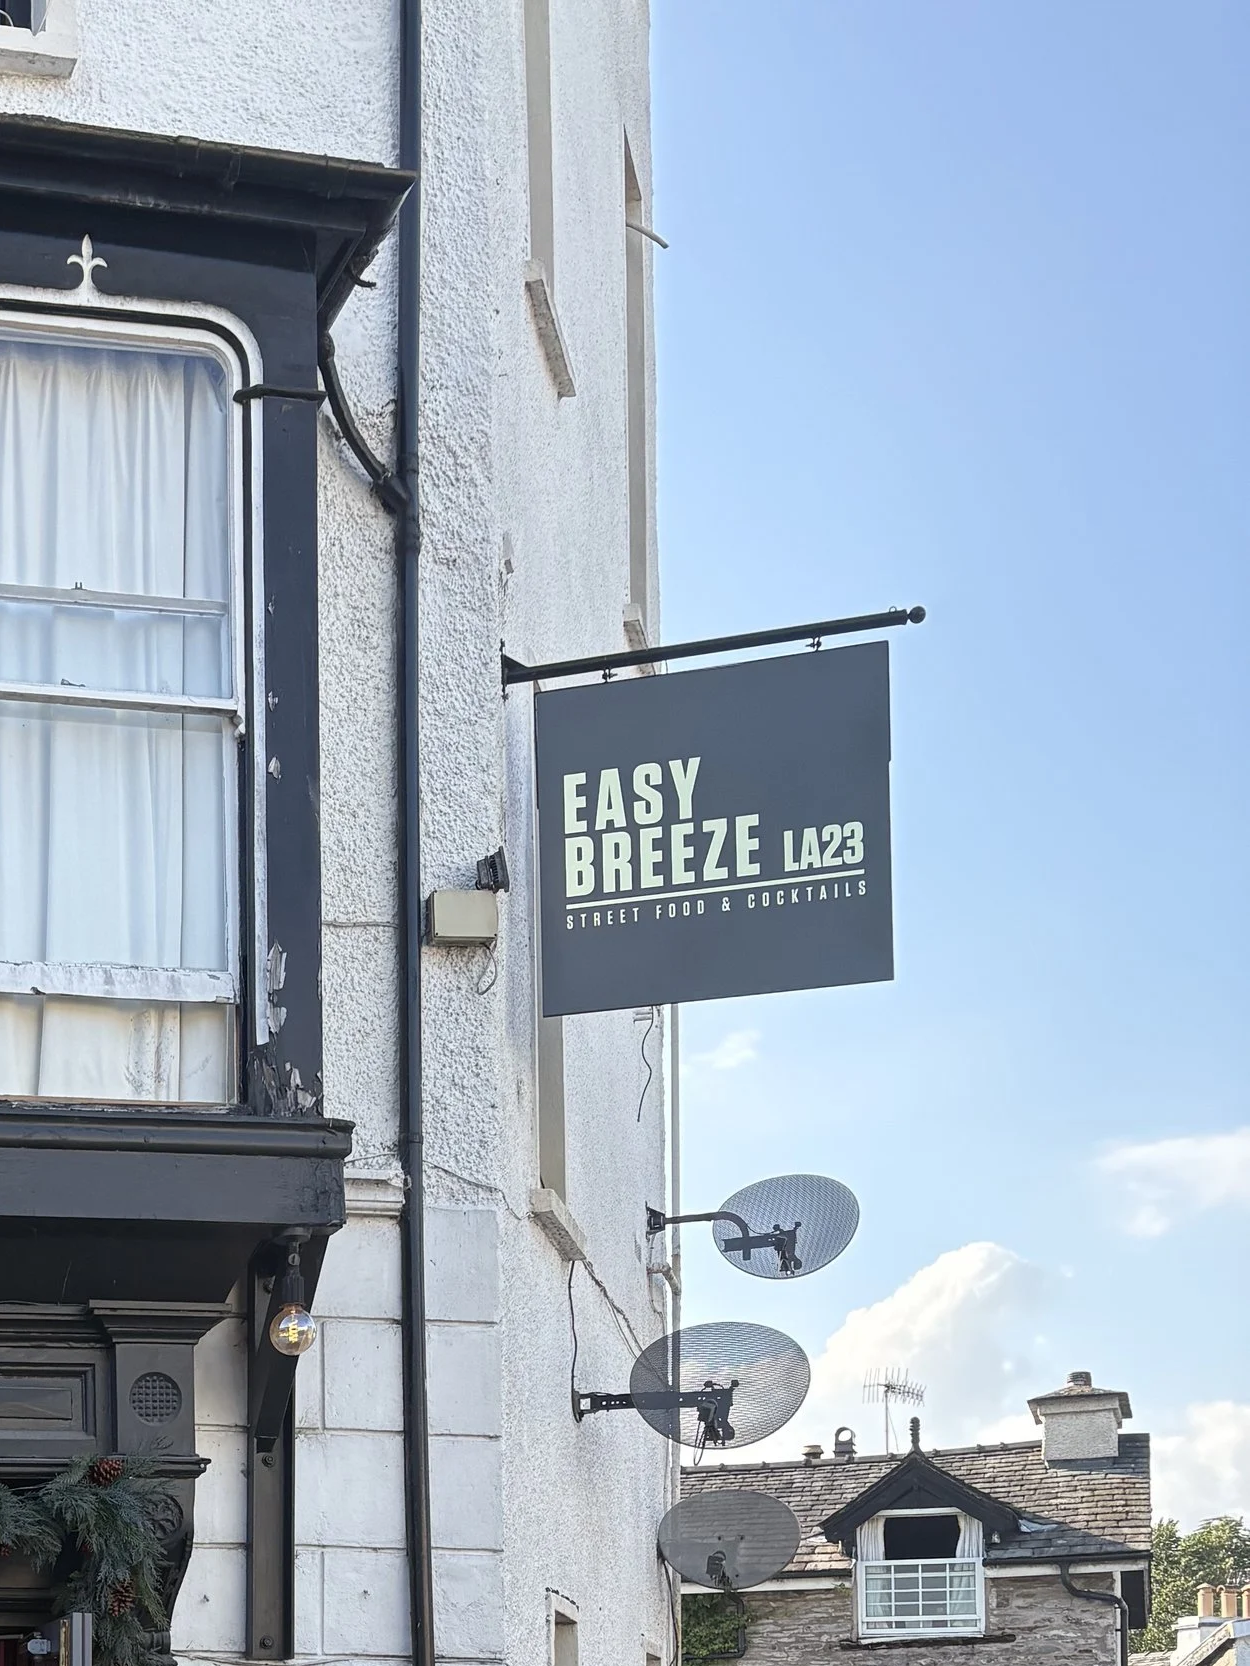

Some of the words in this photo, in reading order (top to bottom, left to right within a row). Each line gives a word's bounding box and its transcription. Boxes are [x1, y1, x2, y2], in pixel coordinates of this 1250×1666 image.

[563, 757, 701, 834] EASY
[564, 813, 761, 898] BREEZE
[783, 821, 864, 872] LA23
[566, 907, 640, 930] STREET
[656, 899, 705, 920] FOOD
[721, 897, 731, 912] &
[748, 880, 867, 909] COCKTAILS
